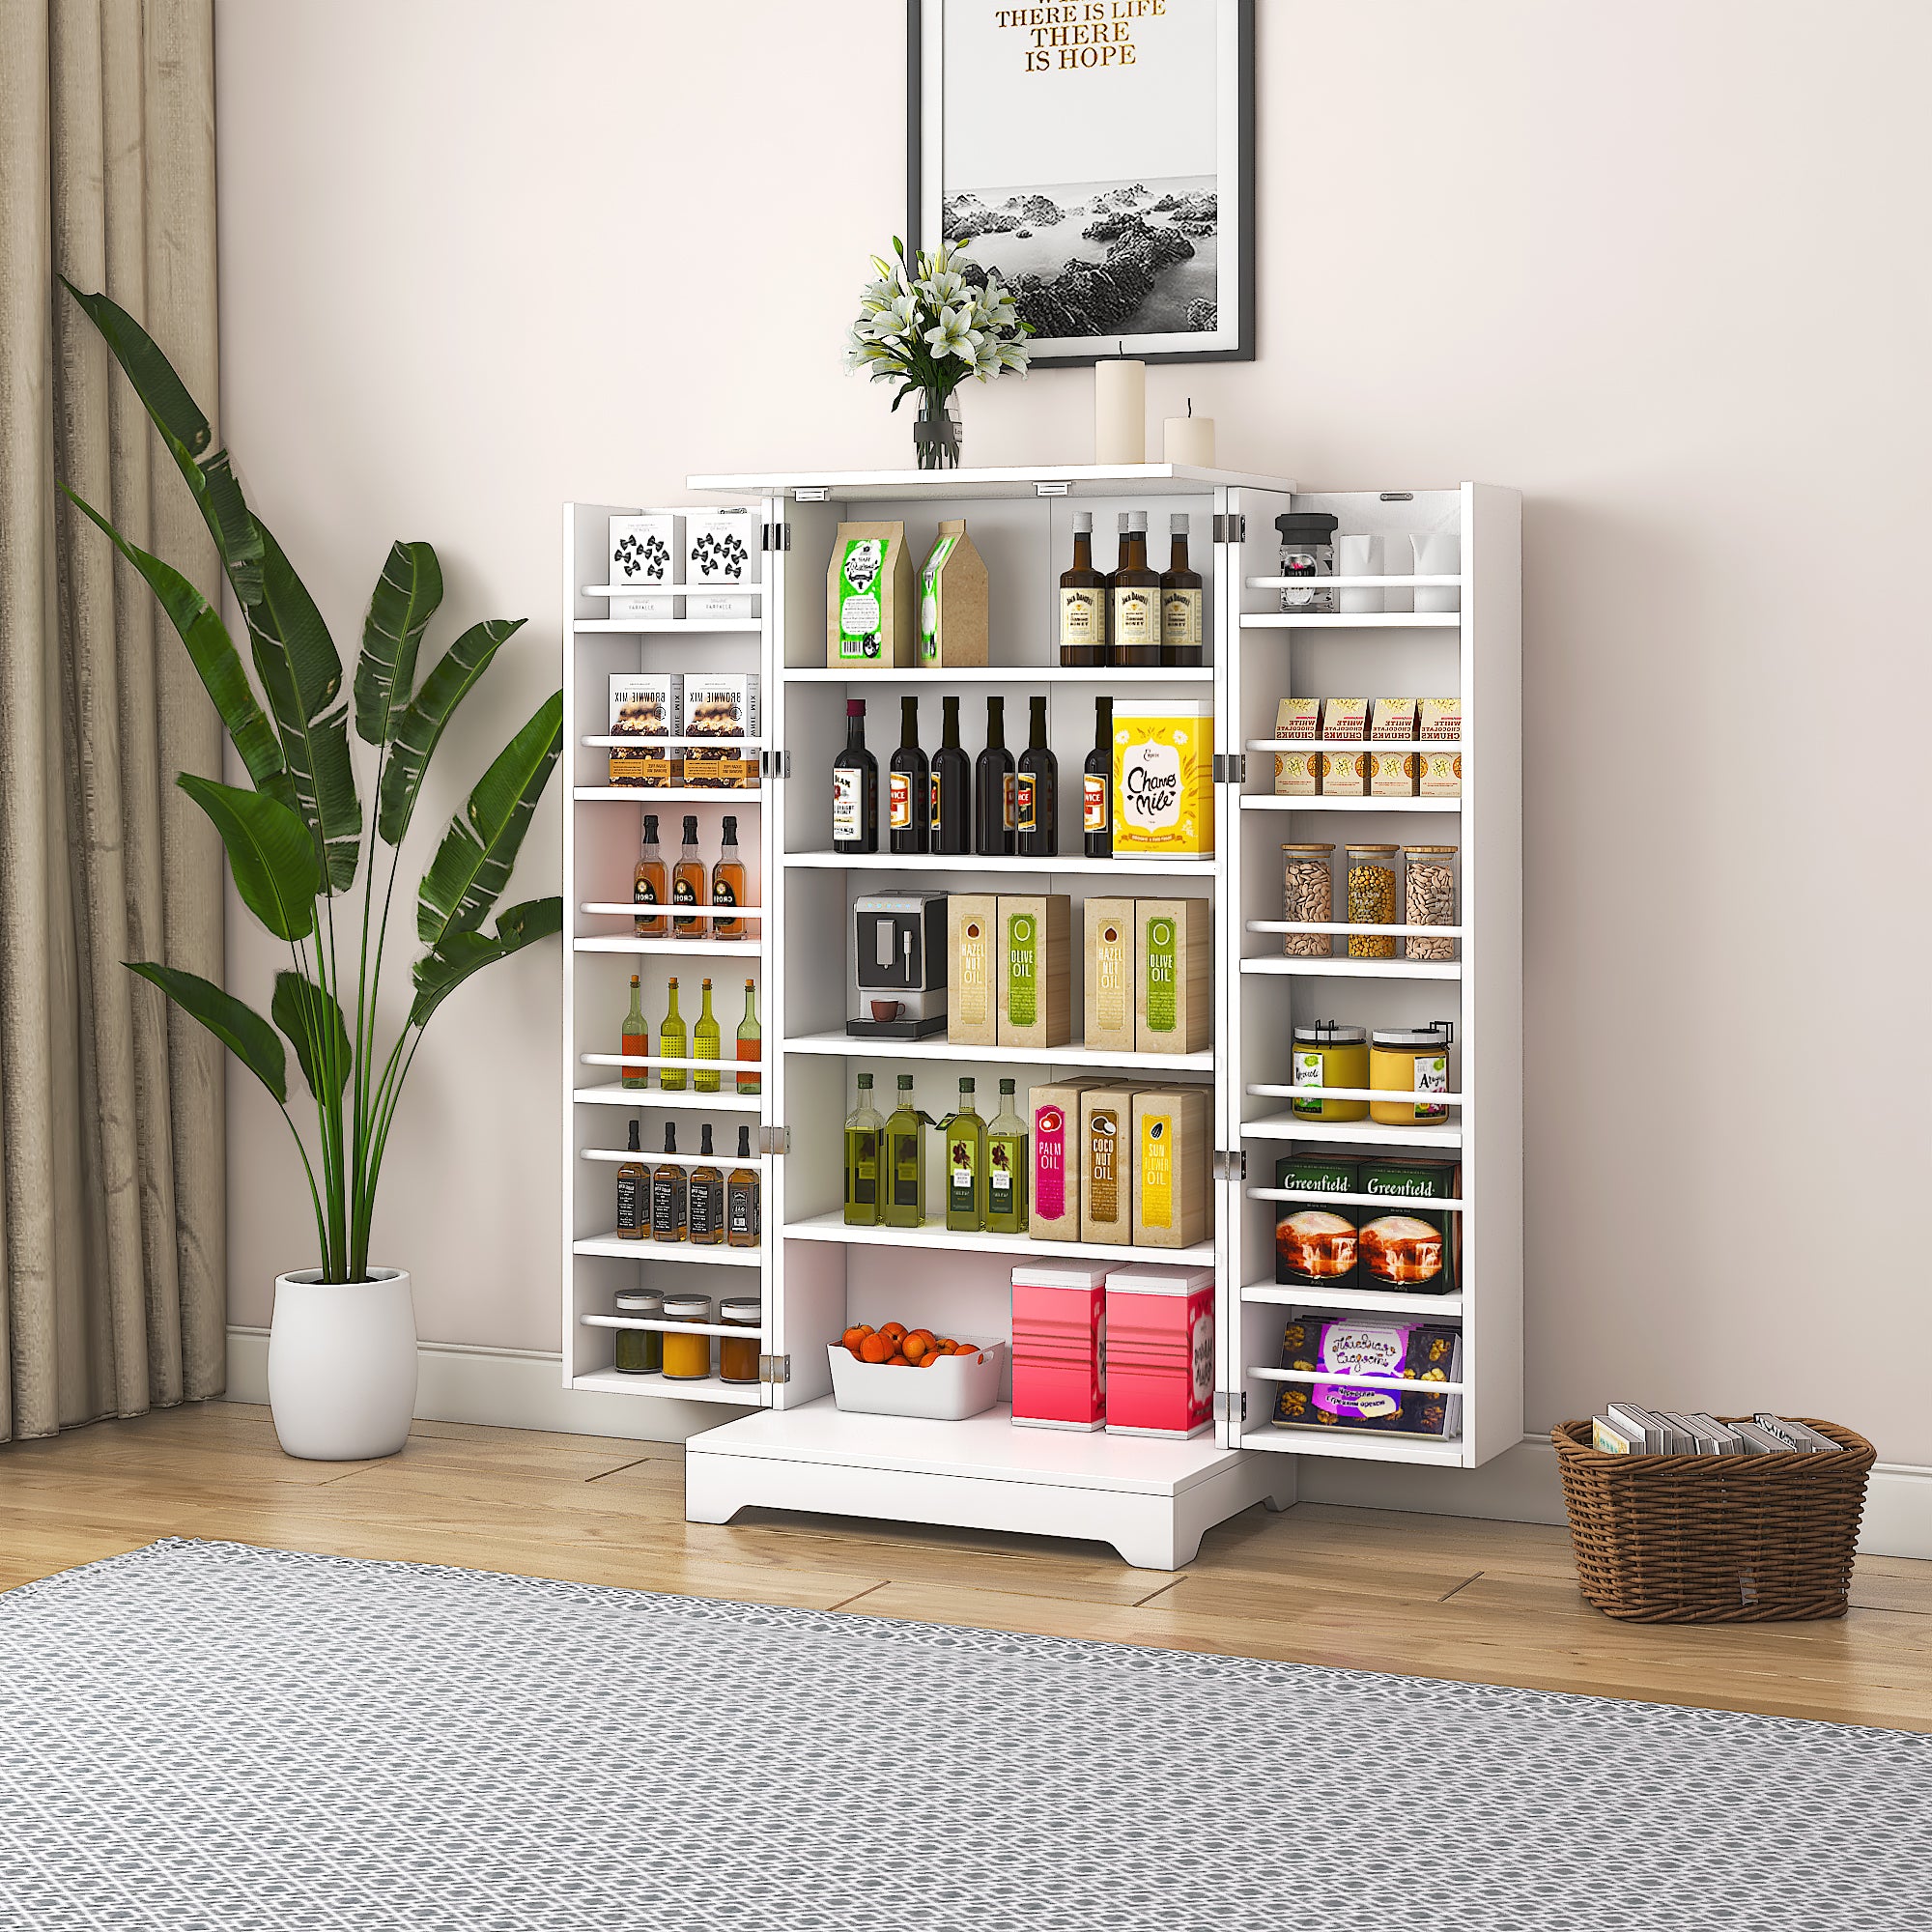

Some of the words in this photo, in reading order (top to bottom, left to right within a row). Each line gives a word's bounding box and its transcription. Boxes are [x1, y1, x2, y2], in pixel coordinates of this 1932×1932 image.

[995, 5, 1077, 28] THERE
[1084, 3, 1104, 21] IS
[1111, 0, 1166, 19] LIFE
[1030, 21, 1129, 48] THERE
[1025, 50, 1050, 72] IS
[1058, 44, 1136, 71] HOPE
[962, 943, 984, 956] HAZEL
[1098, 948, 1122, 961] HAZEL
[966, 957, 980, 970] NUT
[1011, 950, 1034, 964] OLIVE
[1150, 954, 1172, 968] OLIVE
[1012, 963, 1032, 978] OIL
[1103, 961, 1118, 975] NUT
[1151, 968, 1172, 982] OIL
[964, 970, 982, 983] OIL
[1101, 975, 1121, 989] OIL
[1038, 1142, 1061, 1155] PALM
[1093, 1139, 1114, 1152] COCO
[1149, 1144, 1165, 1157] SUN
[1040, 1155, 1060, 1170] OIL
[1095, 1152, 1112, 1166] NUT
[1094, 1166, 1113, 1180] OIL
[1147, 1171, 1167, 1185] OIL
[1284, 1173, 1349, 1192] Greenfield
[1367, 1178, 1433, 1197] Greenfield
